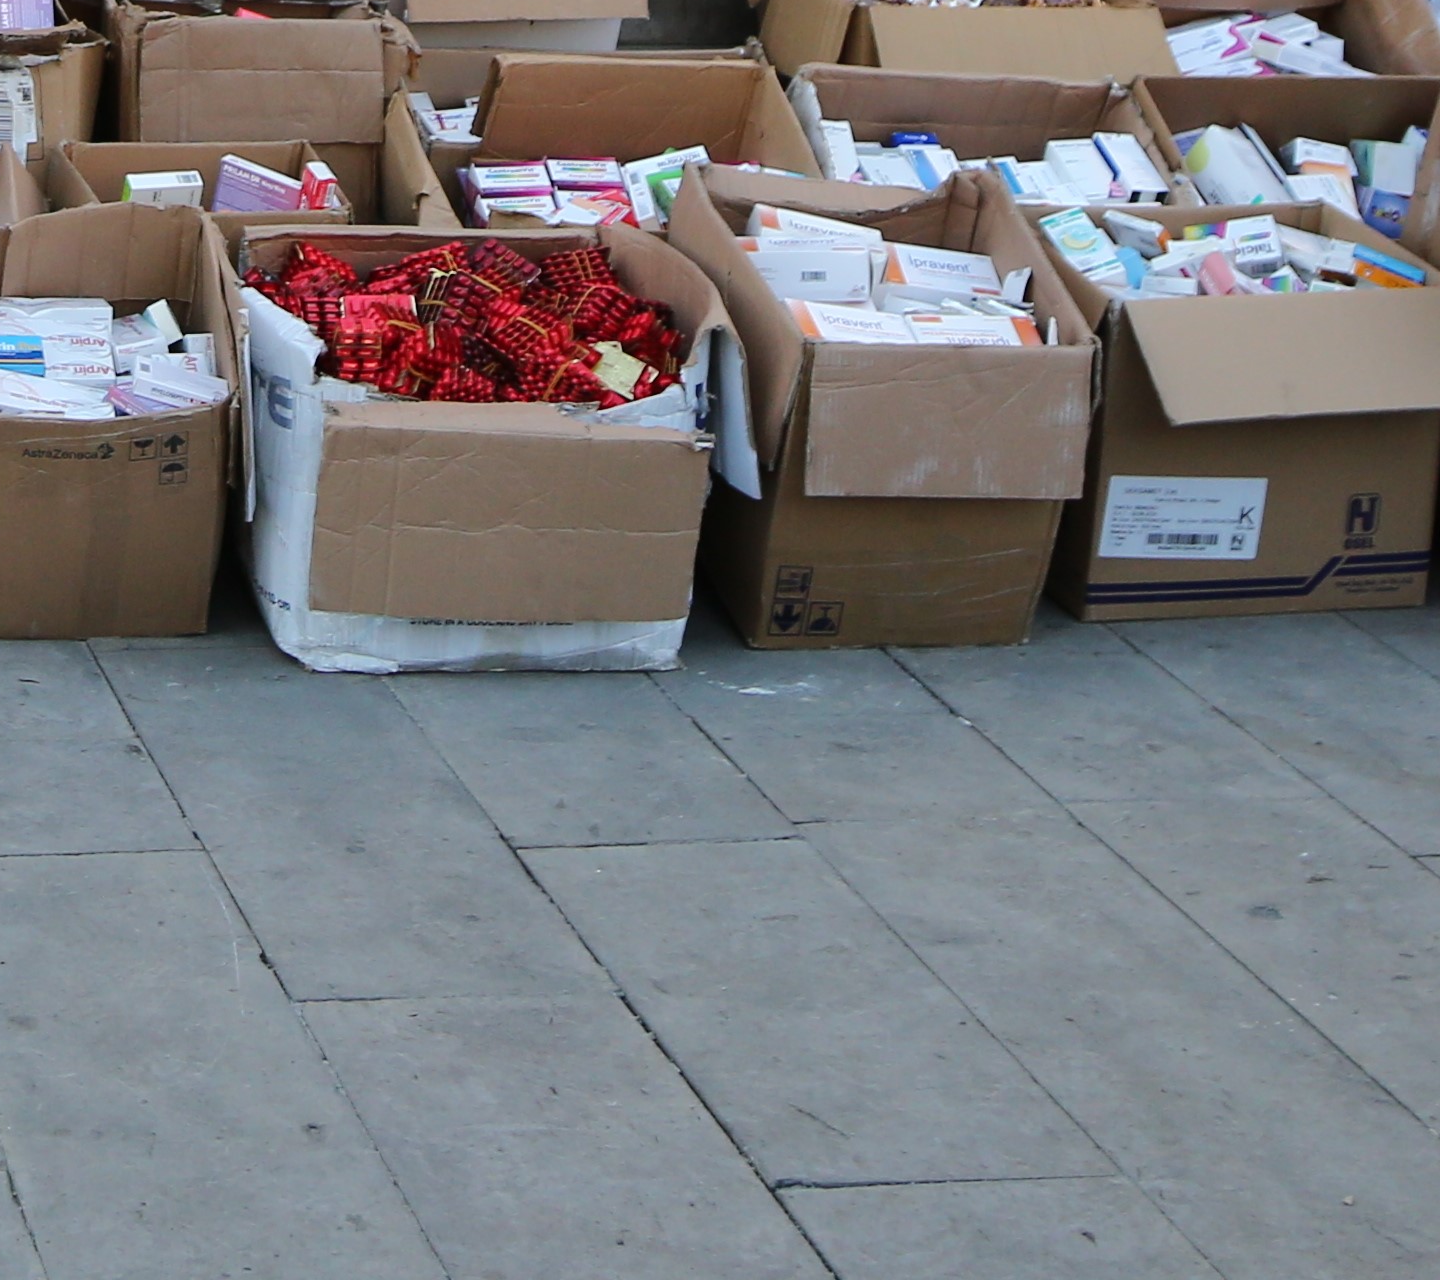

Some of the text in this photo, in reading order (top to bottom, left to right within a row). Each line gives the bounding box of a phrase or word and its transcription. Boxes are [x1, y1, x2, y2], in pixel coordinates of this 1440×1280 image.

[909, 254, 971, 273] Ipravent
[820, 312, 885, 331] Ipravent
[22, 446, 100, 462] AstraZeneca
